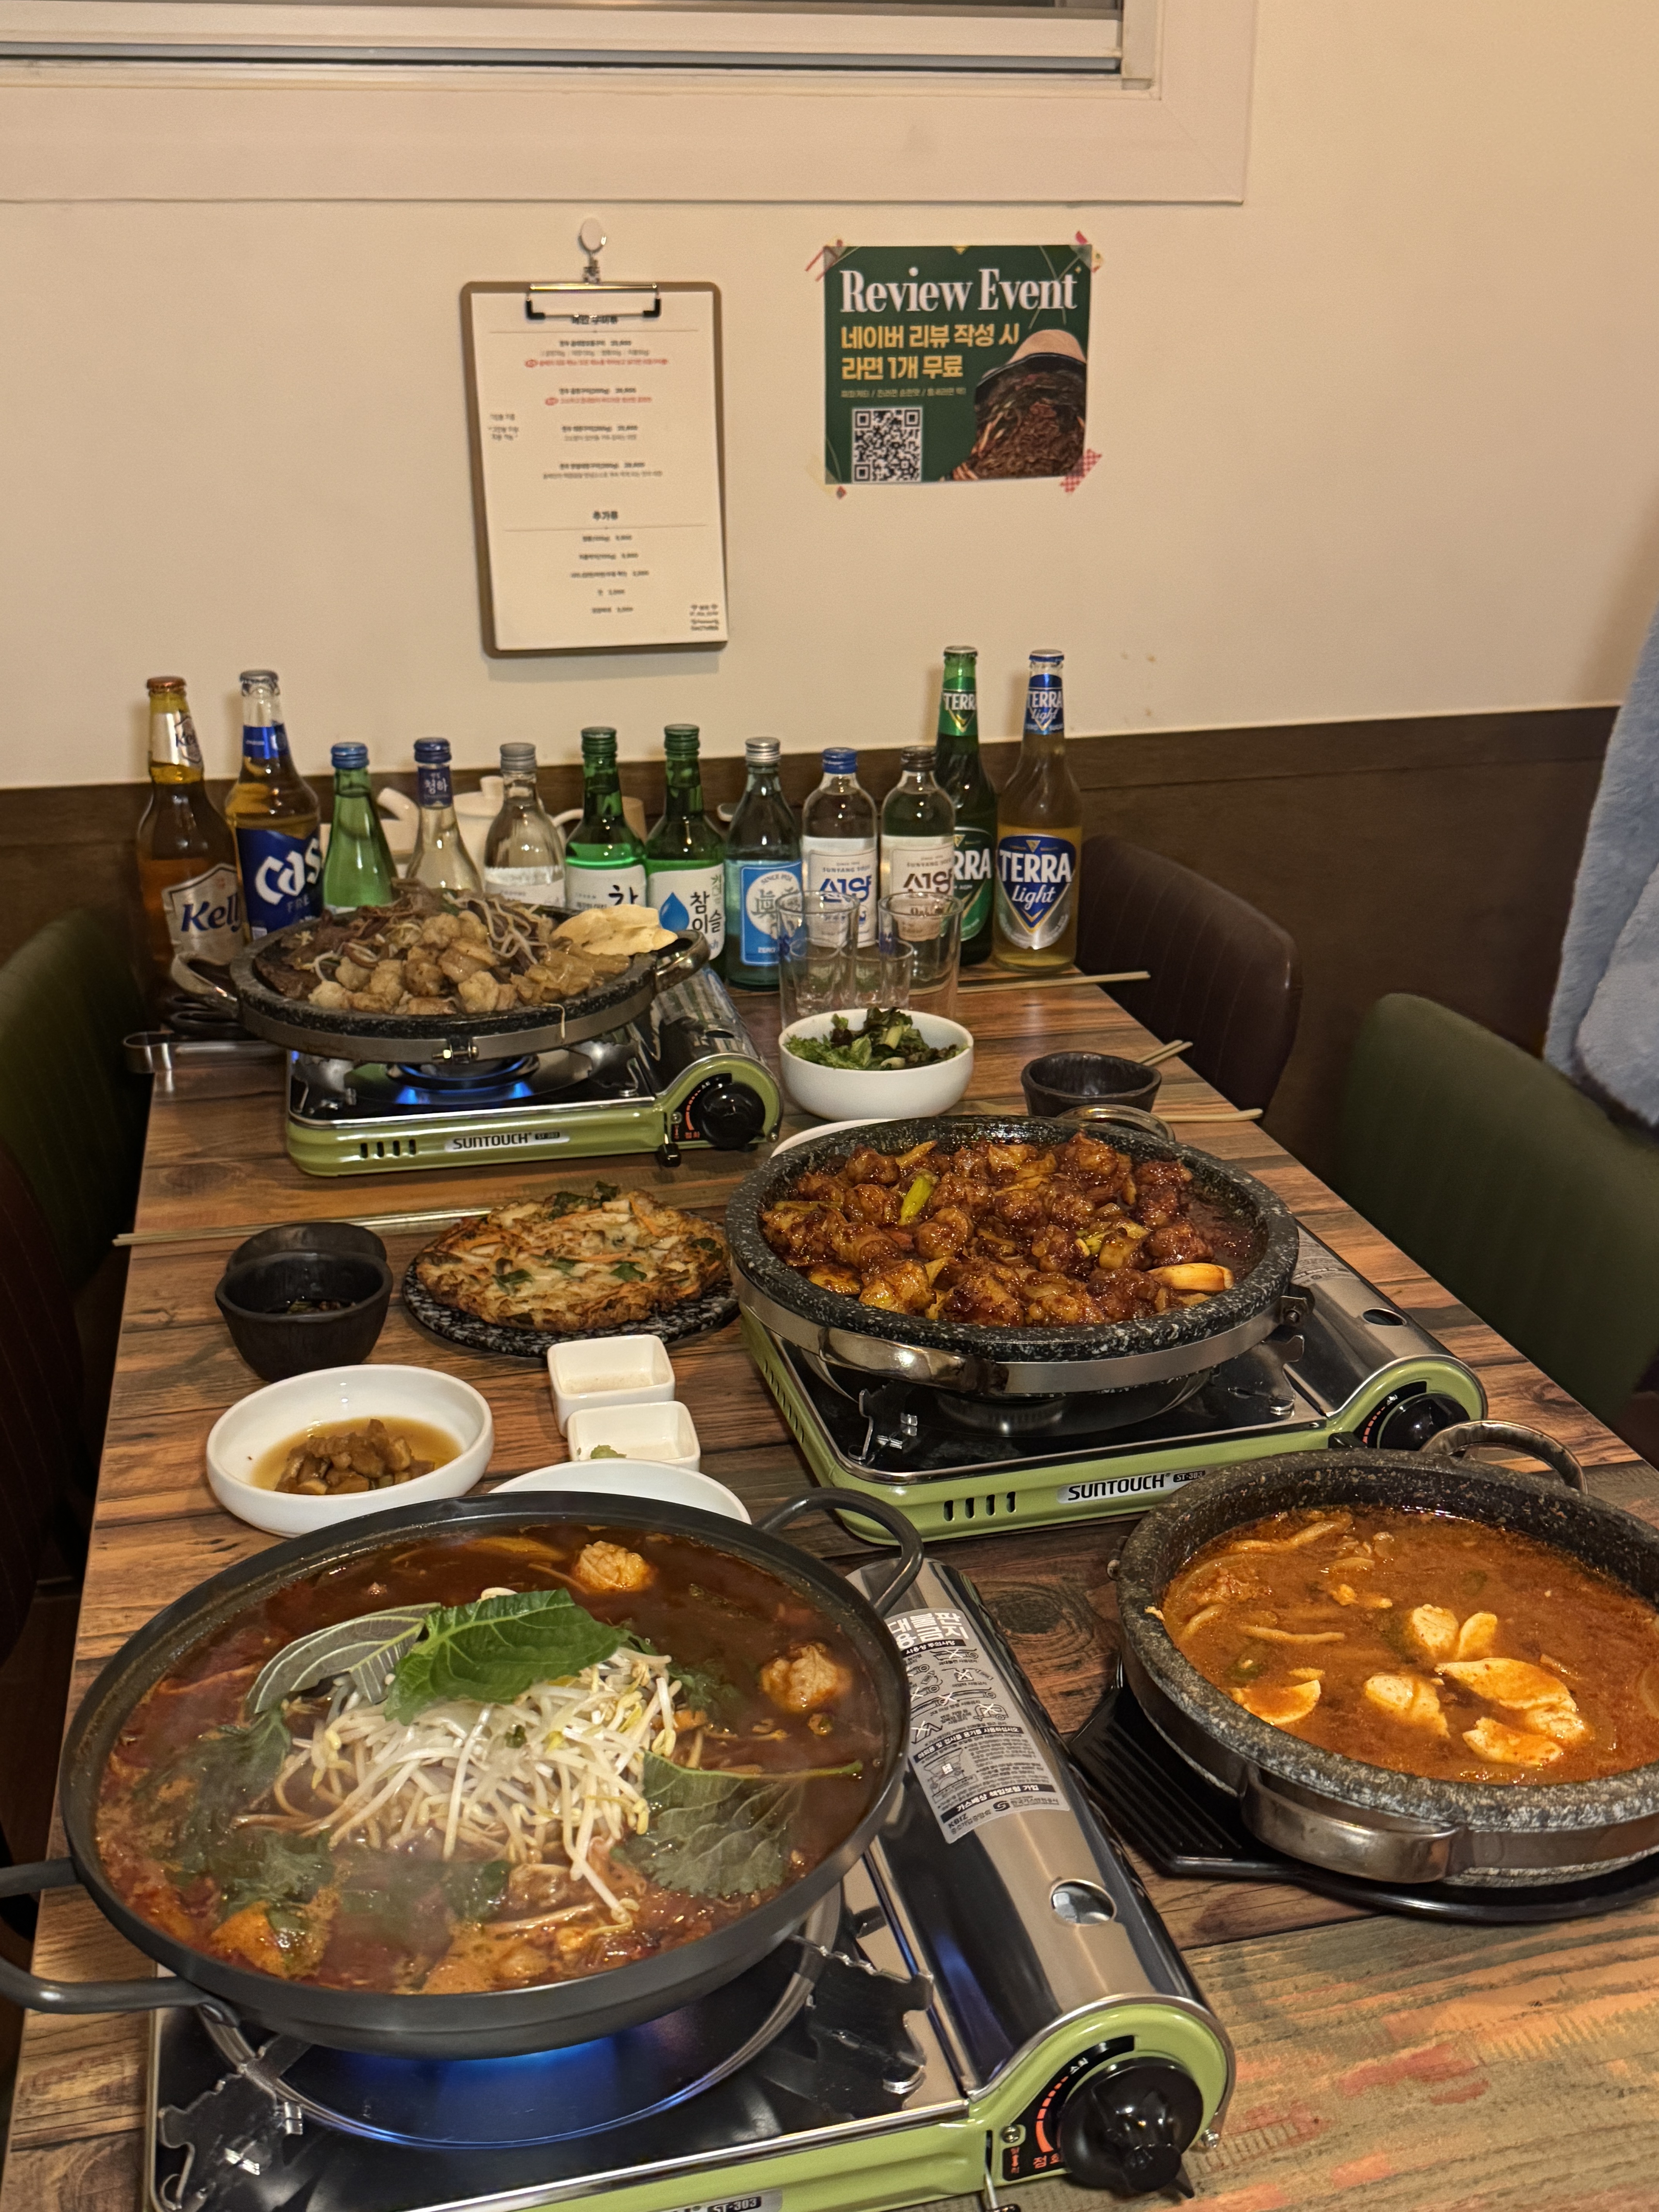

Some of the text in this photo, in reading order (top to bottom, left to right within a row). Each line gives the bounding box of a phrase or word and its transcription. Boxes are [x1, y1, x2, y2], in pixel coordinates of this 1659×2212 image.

[840, 267, 1079, 312] Review Event
[841, 323, 1020, 349] 네이버 리뷰 작성 시
[842, 355, 963, 380] 라면 1개 무료
[943, 692, 976, 711] TERR
[255, 838, 321, 905] Cas
[954, 848, 992, 880] RRA
[999, 849, 1072, 883] TERRA
[1011, 884, 1056, 910] Light
[453, 1132, 528, 1150] SUNTOUCH
[1068, 1474, 1164, 1501] SUNTOUCH
[887, 1612, 962, 1634] 대불판
[895, 1626, 969, 1650] 용금지
[948, 1813, 968, 1829] KBIZ
